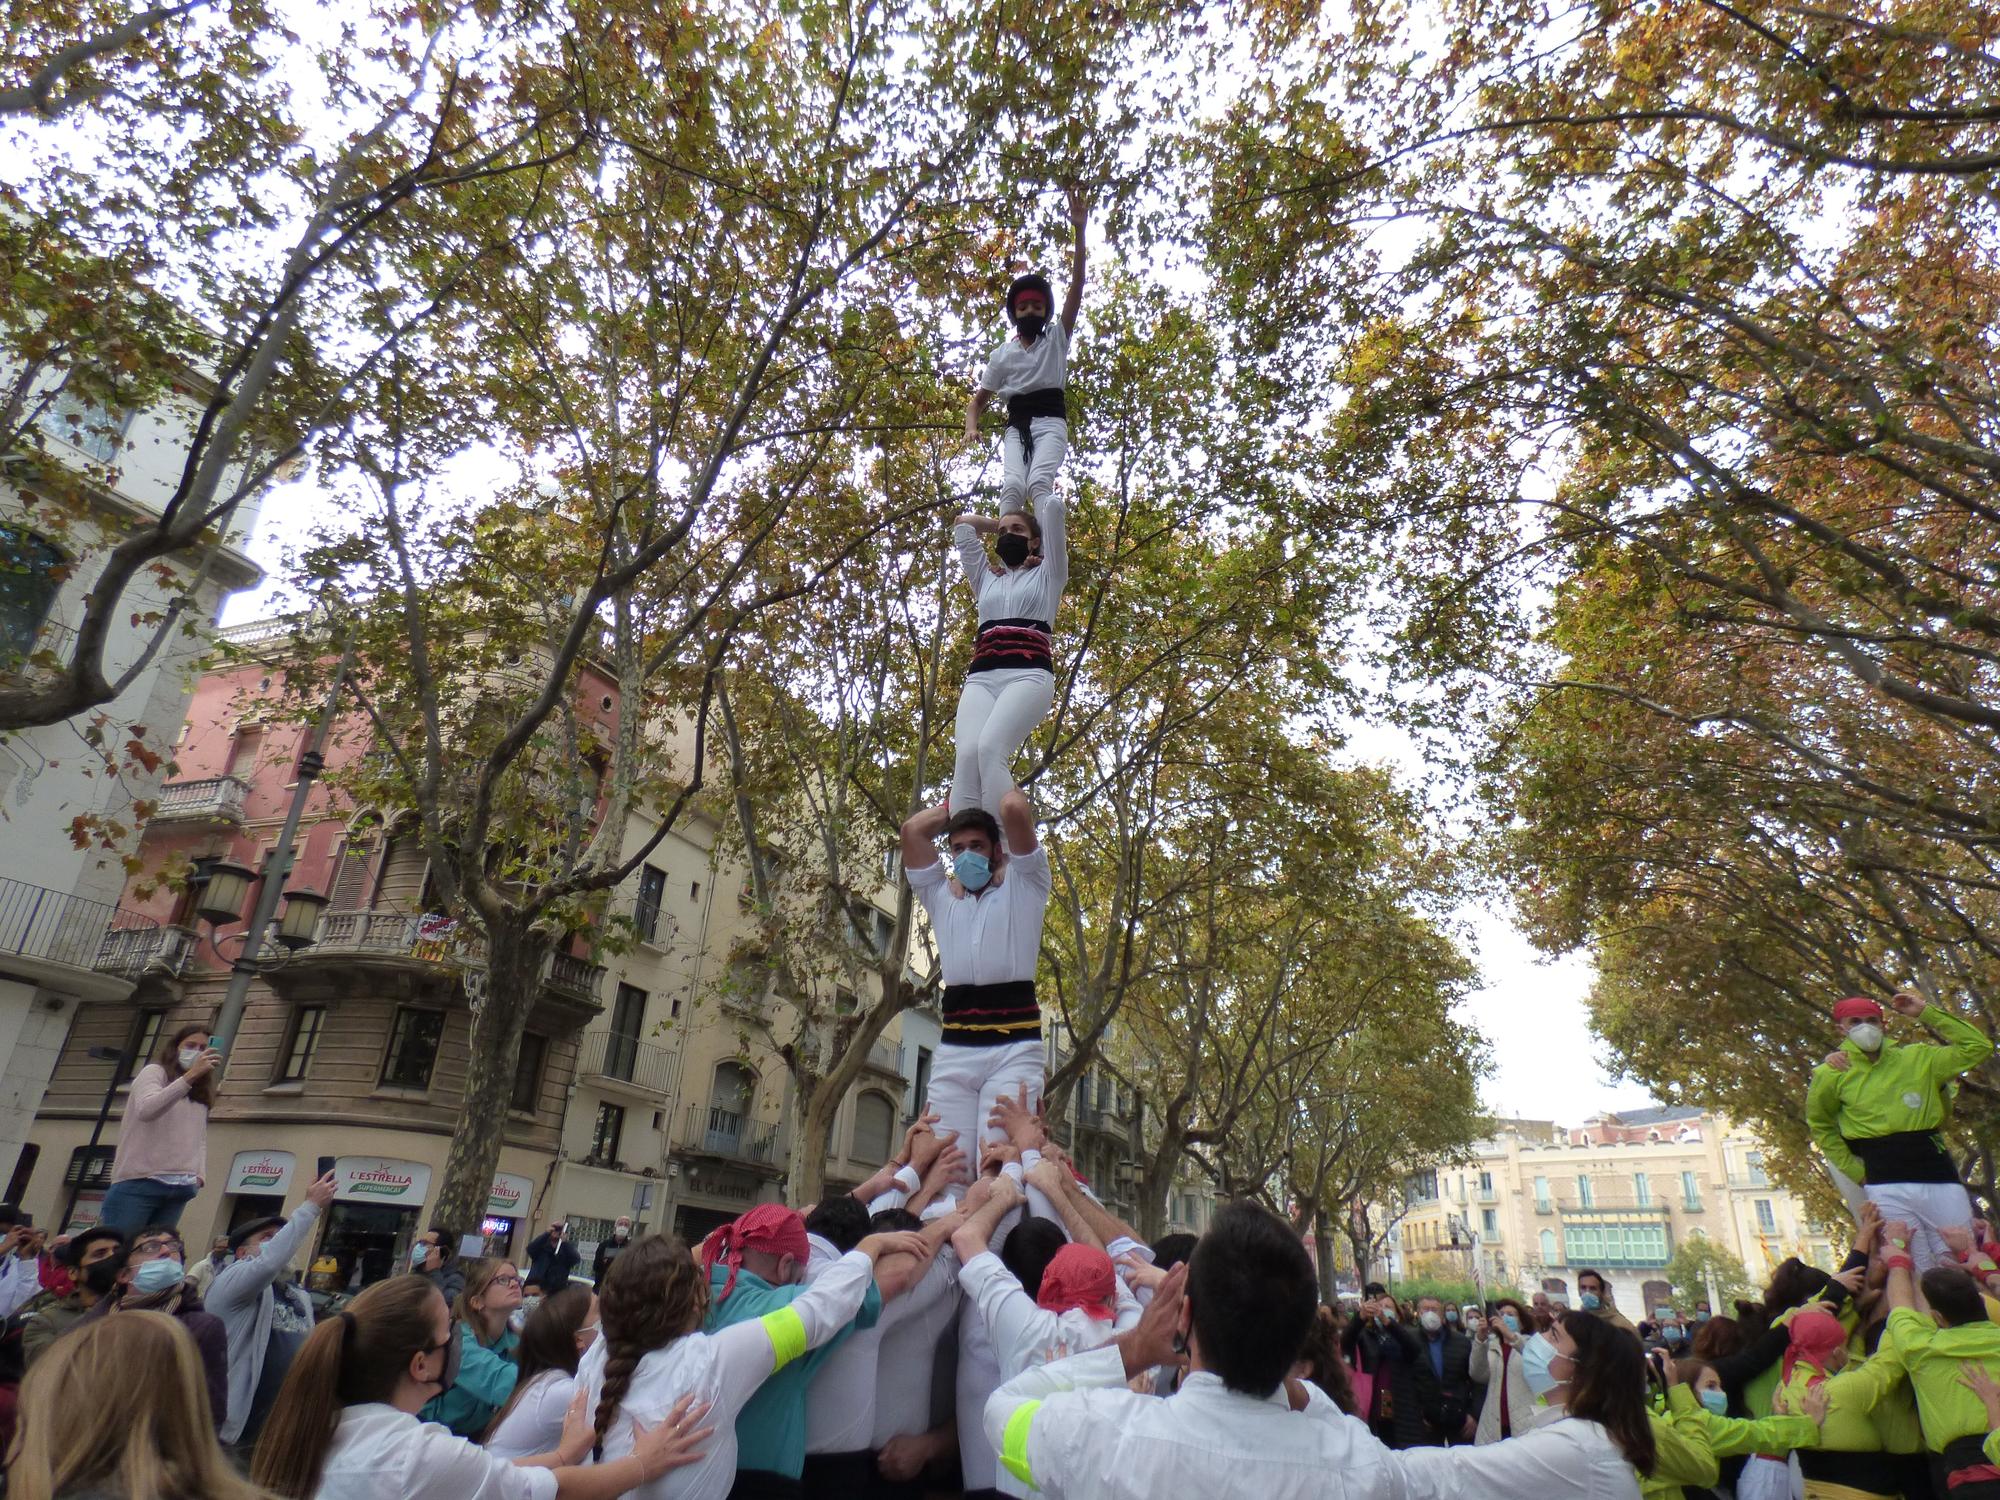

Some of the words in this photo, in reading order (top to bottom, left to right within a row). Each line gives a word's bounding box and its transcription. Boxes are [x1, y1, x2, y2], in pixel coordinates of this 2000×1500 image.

[242, 1165, 284, 1175] L'ESTRELLA
[350, 1171, 412, 1184] L'ESTRELLA
[358, 1184, 401, 1193] SUPERMERCAT
[690, 1179, 702, 1192] EL
